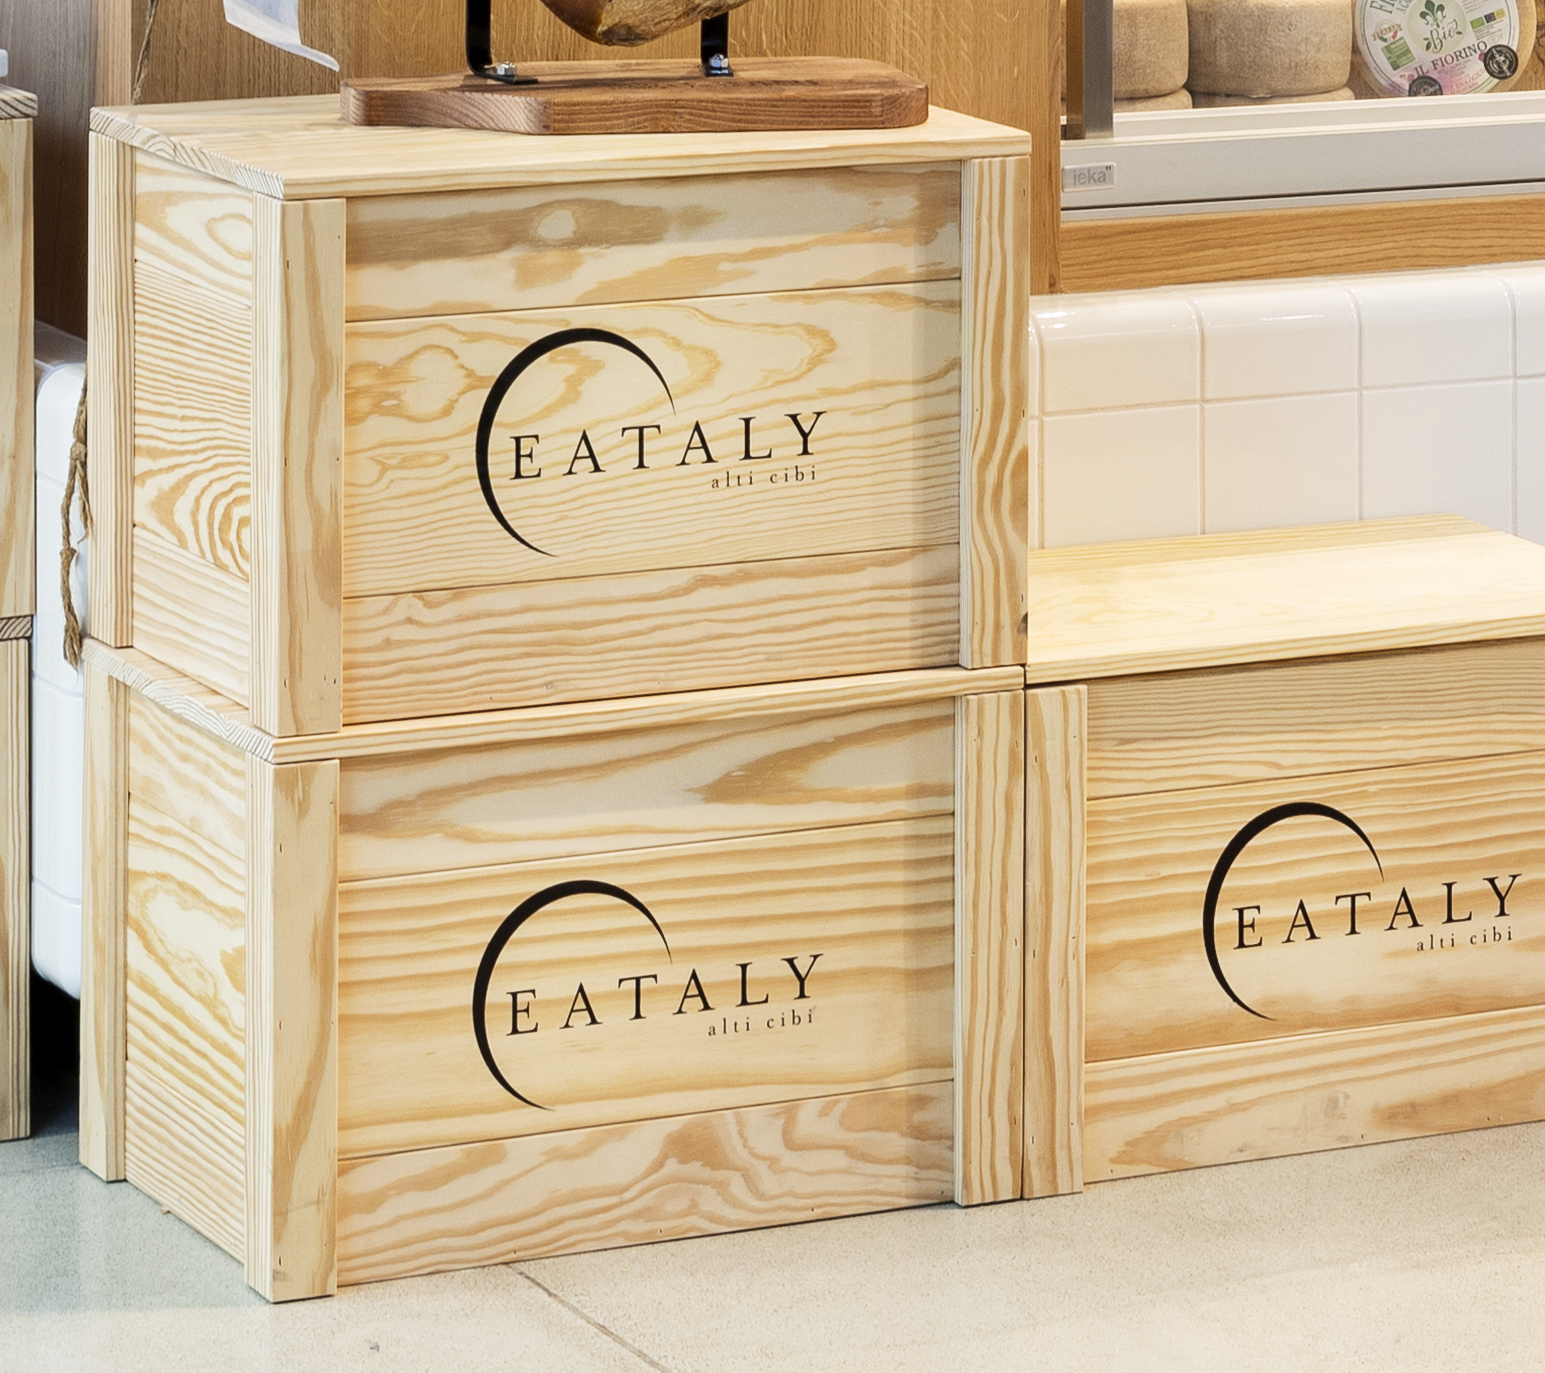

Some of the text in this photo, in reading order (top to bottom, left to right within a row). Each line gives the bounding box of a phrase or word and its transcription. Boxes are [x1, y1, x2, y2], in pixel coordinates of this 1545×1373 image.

[1430, 21, 1457, 54] Bio
[1413, 40, 1488, 77] IL FIORINO
[509, 410, 827, 479] EATALY
[710, 465, 819, 491] alti cibi
[1233, 873, 1523, 952] EATALY
[1415, 923, 1516, 954] alti cibi
[506, 953, 824, 1037] EATALY
[707, 1007, 816, 1037] alti cibi
